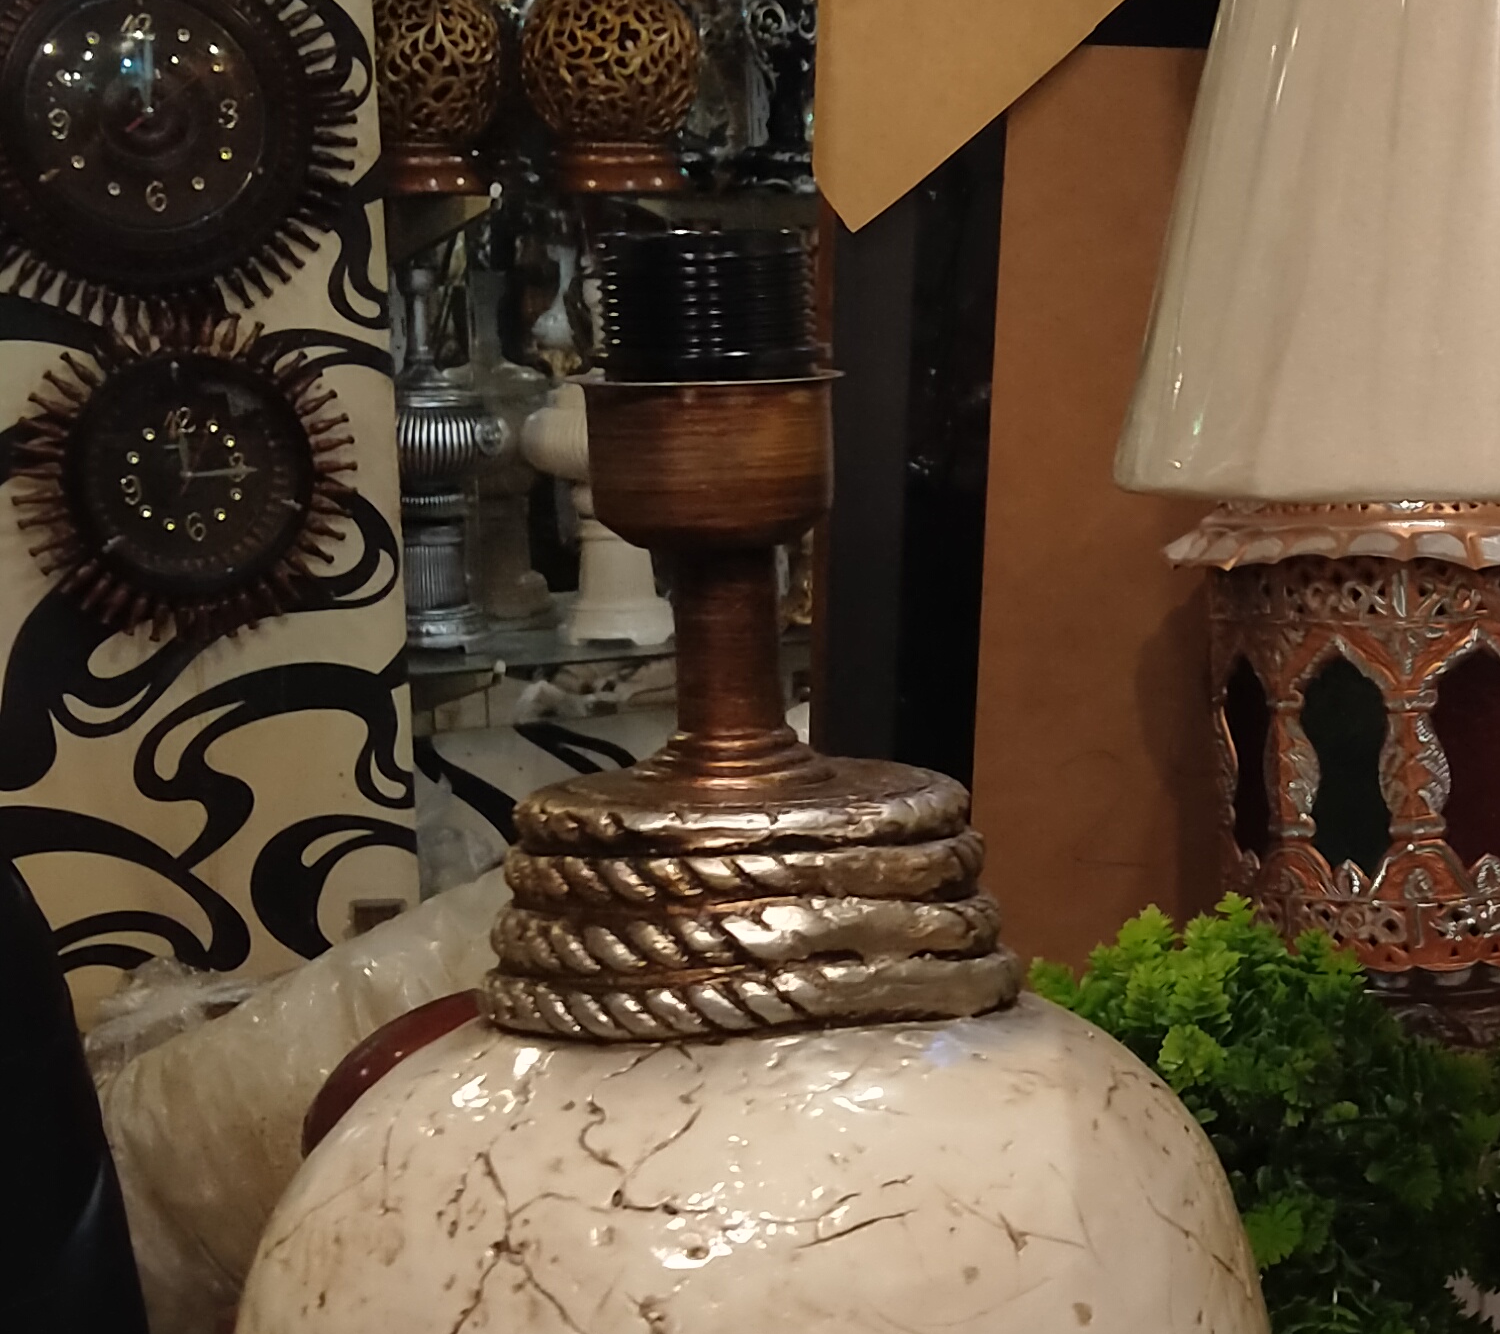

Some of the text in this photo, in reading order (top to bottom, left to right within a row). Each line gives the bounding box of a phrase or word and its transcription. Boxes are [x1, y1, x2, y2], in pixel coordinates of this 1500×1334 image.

[48, 108, 71, 140] 9
[217, 98, 240, 129] 3
[145, 180, 168, 212] 6
[163, 406, 197, 435] 12
[120, 474, 142, 505] 9
[185, 512, 207, 541] 6
